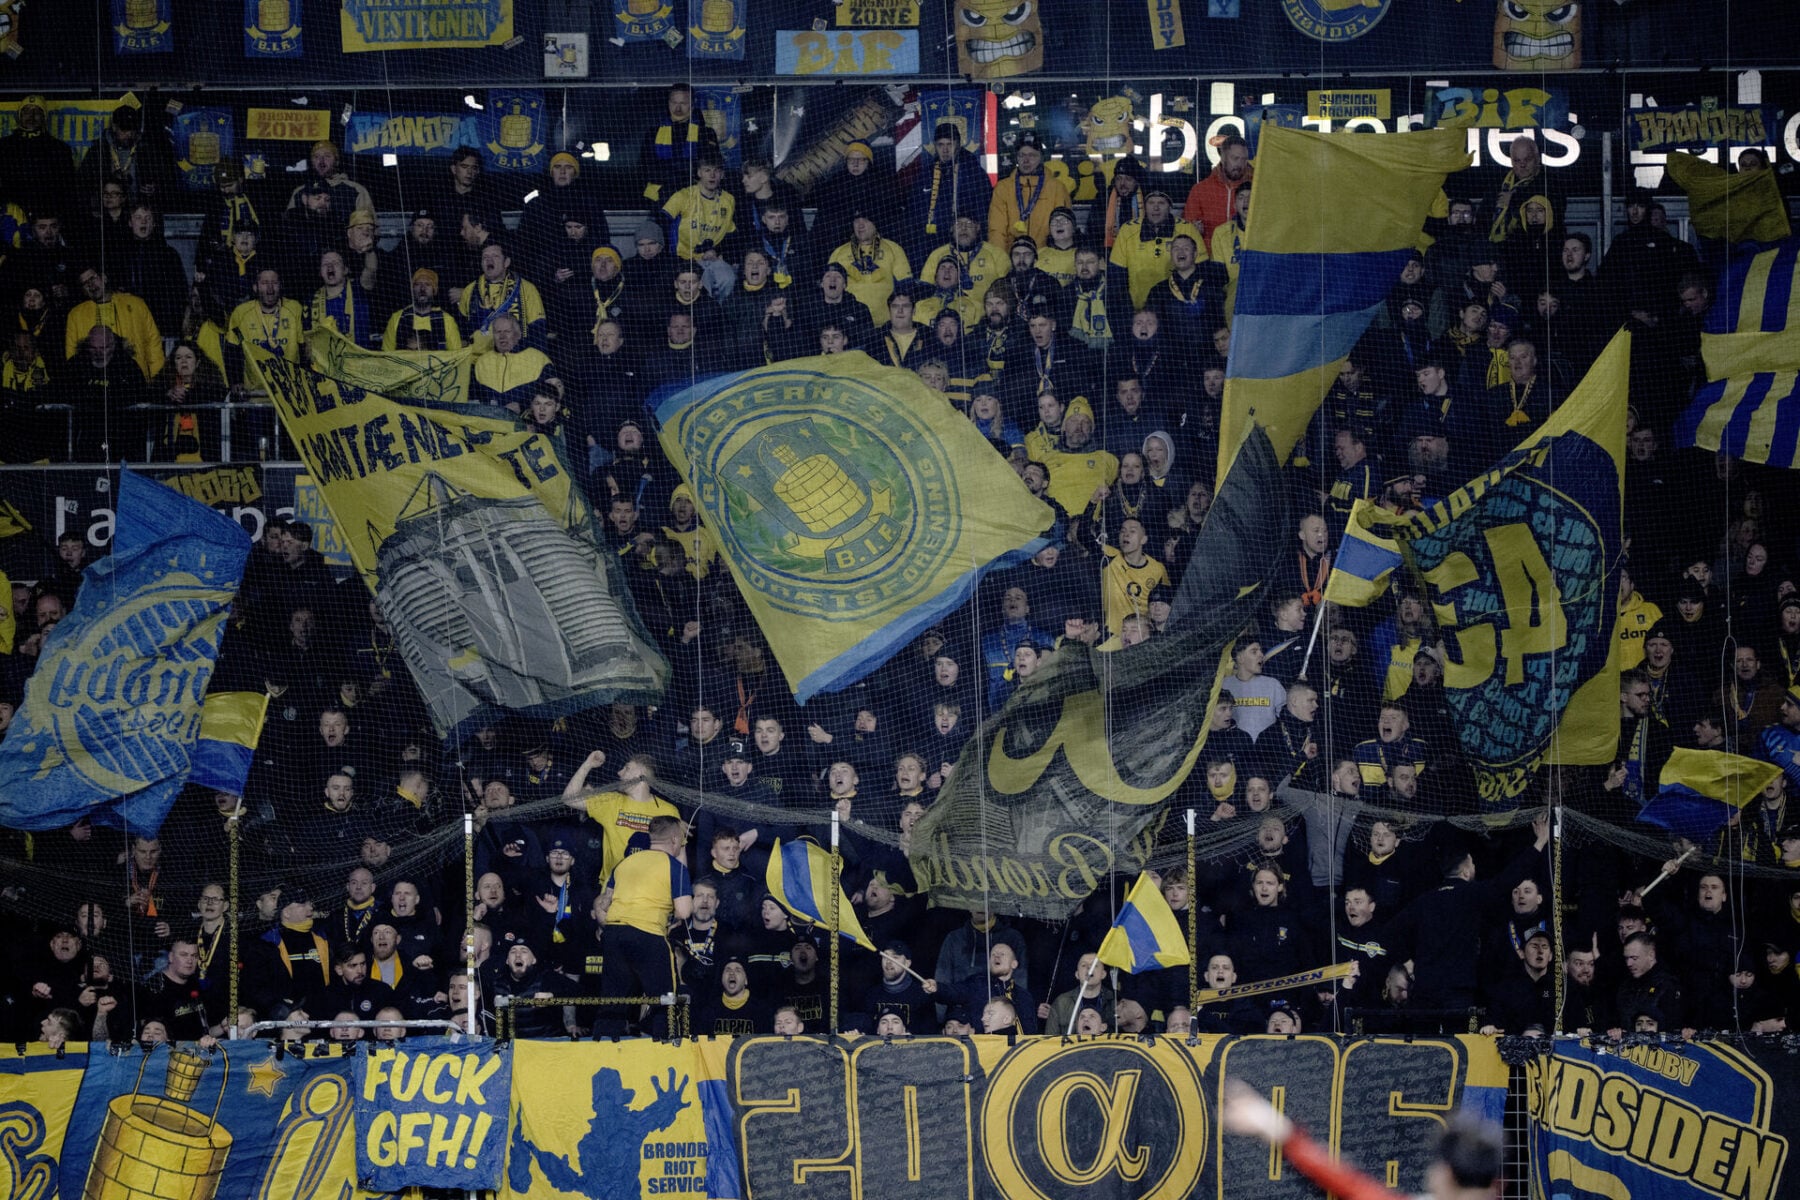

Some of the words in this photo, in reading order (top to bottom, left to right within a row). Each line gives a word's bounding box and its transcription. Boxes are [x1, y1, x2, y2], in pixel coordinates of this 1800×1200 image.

[361, 10, 487, 40] VESTEGNEN
[849, 8, 912, 25] ZONE
[257, 121, 320, 138] ZONE
[714, 1018, 755, 1036] ALPHA
[363, 1049, 502, 1105] FUCK
[367, 1112, 493, 1171] GFH!
[643, 1143, 708, 1160] BRØNDB
[664, 1159, 697, 1176] RIOT
